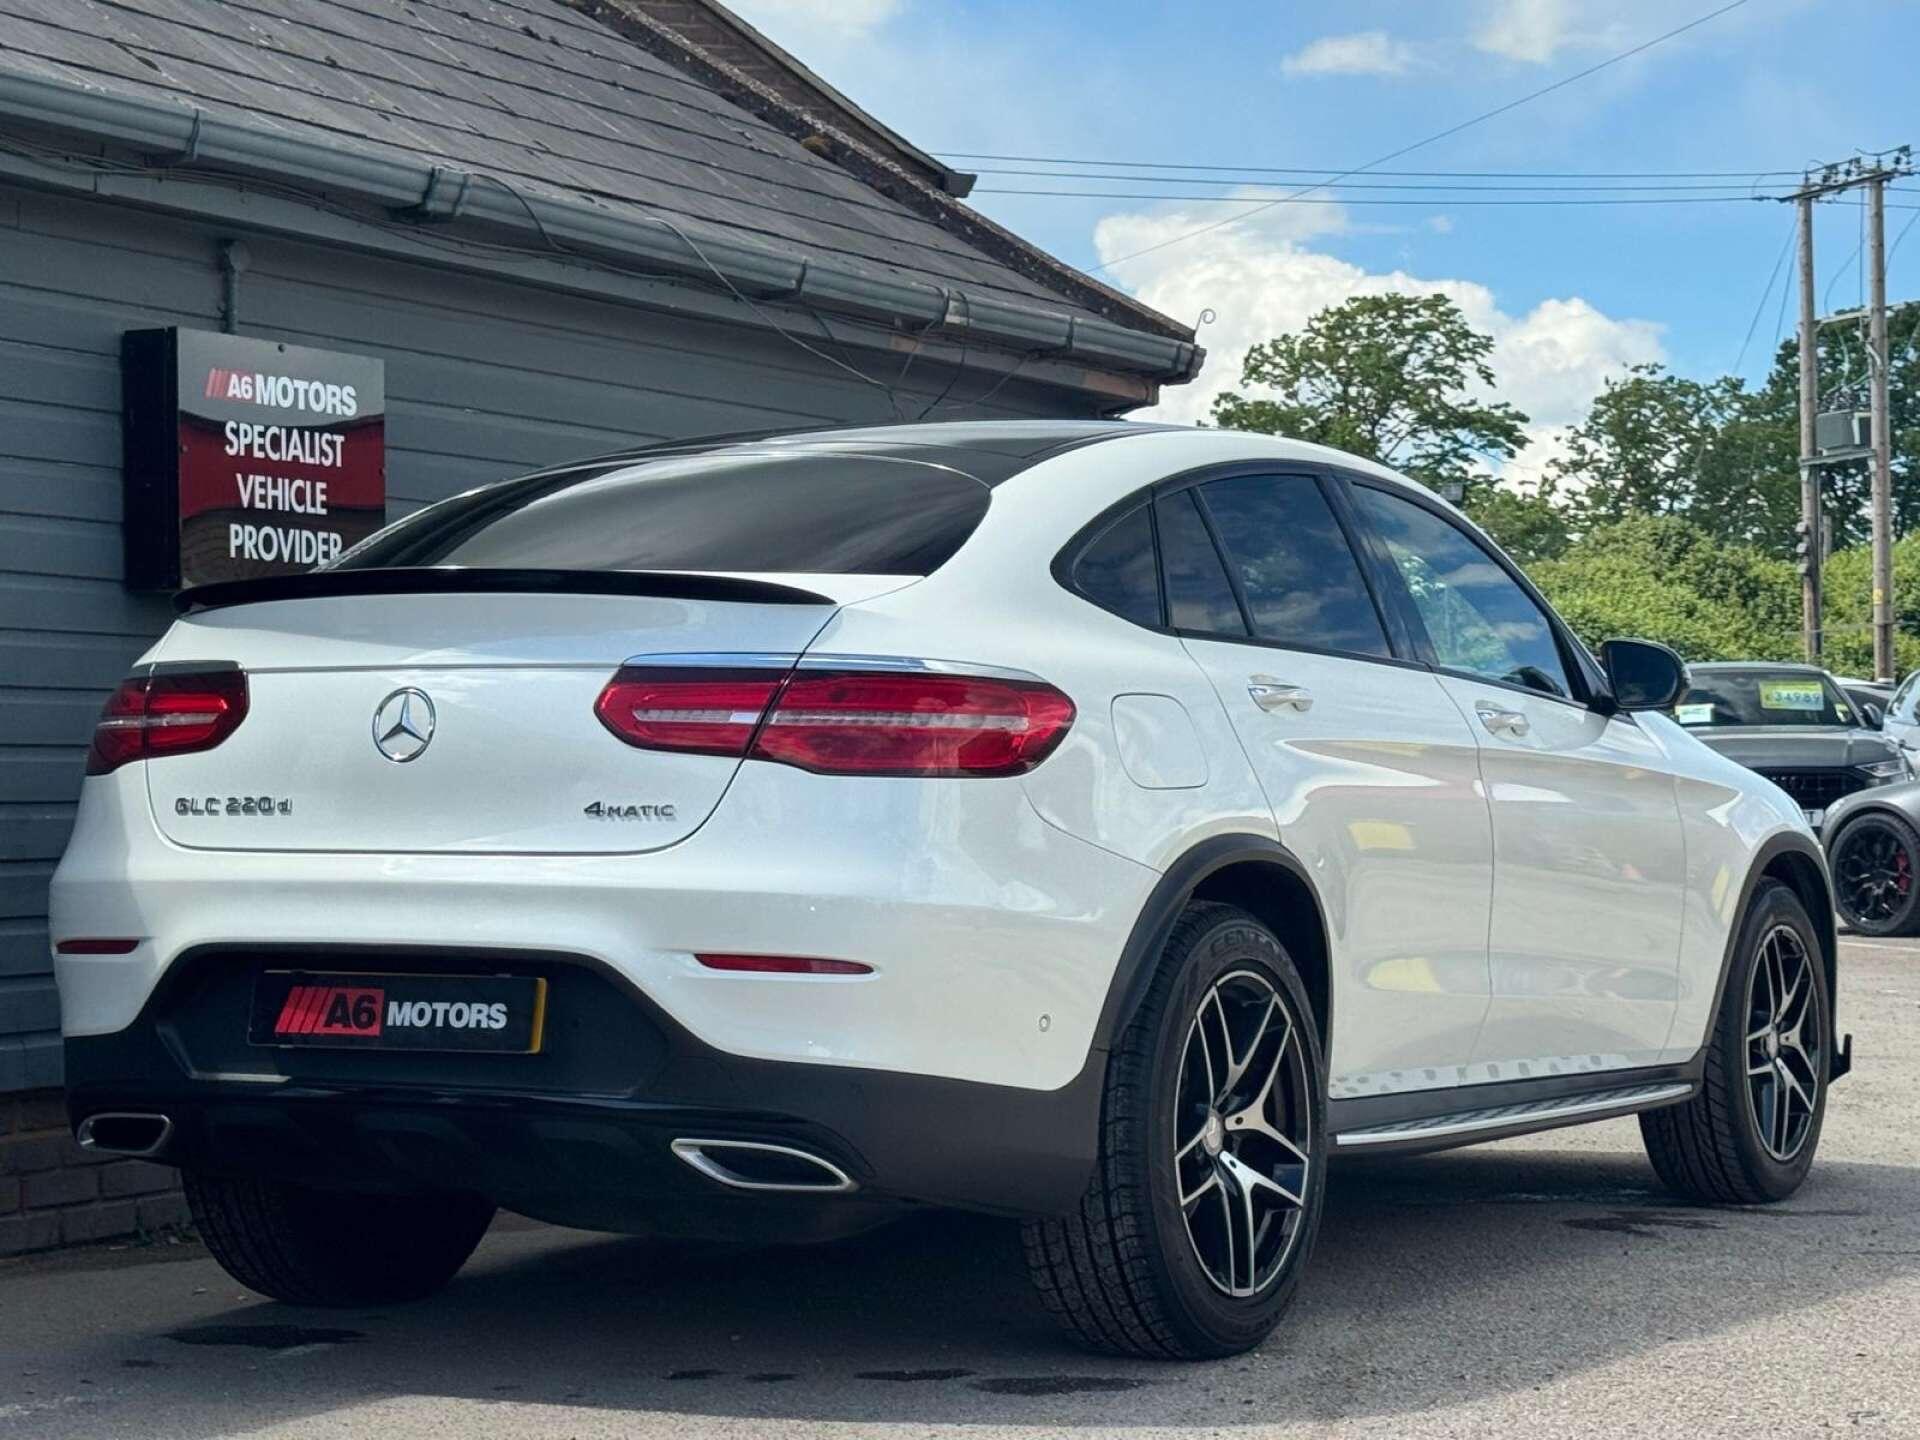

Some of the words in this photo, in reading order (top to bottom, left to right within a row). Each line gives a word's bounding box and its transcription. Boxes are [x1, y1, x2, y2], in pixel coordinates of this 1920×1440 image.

[226, 373, 253, 399] A6
[255, 374, 357, 416] MOTORS
[224, 420, 345, 467] SPECIALIST
[235, 473, 327, 515] VEHICLE
[229, 523, 343, 566] PROVIDER
[175, 797, 221, 816] GLC
[583, 801, 676, 819] 4MATIC
[323, 993, 377, 1029] A6
[386, 1001, 508, 1029] MOTORS
